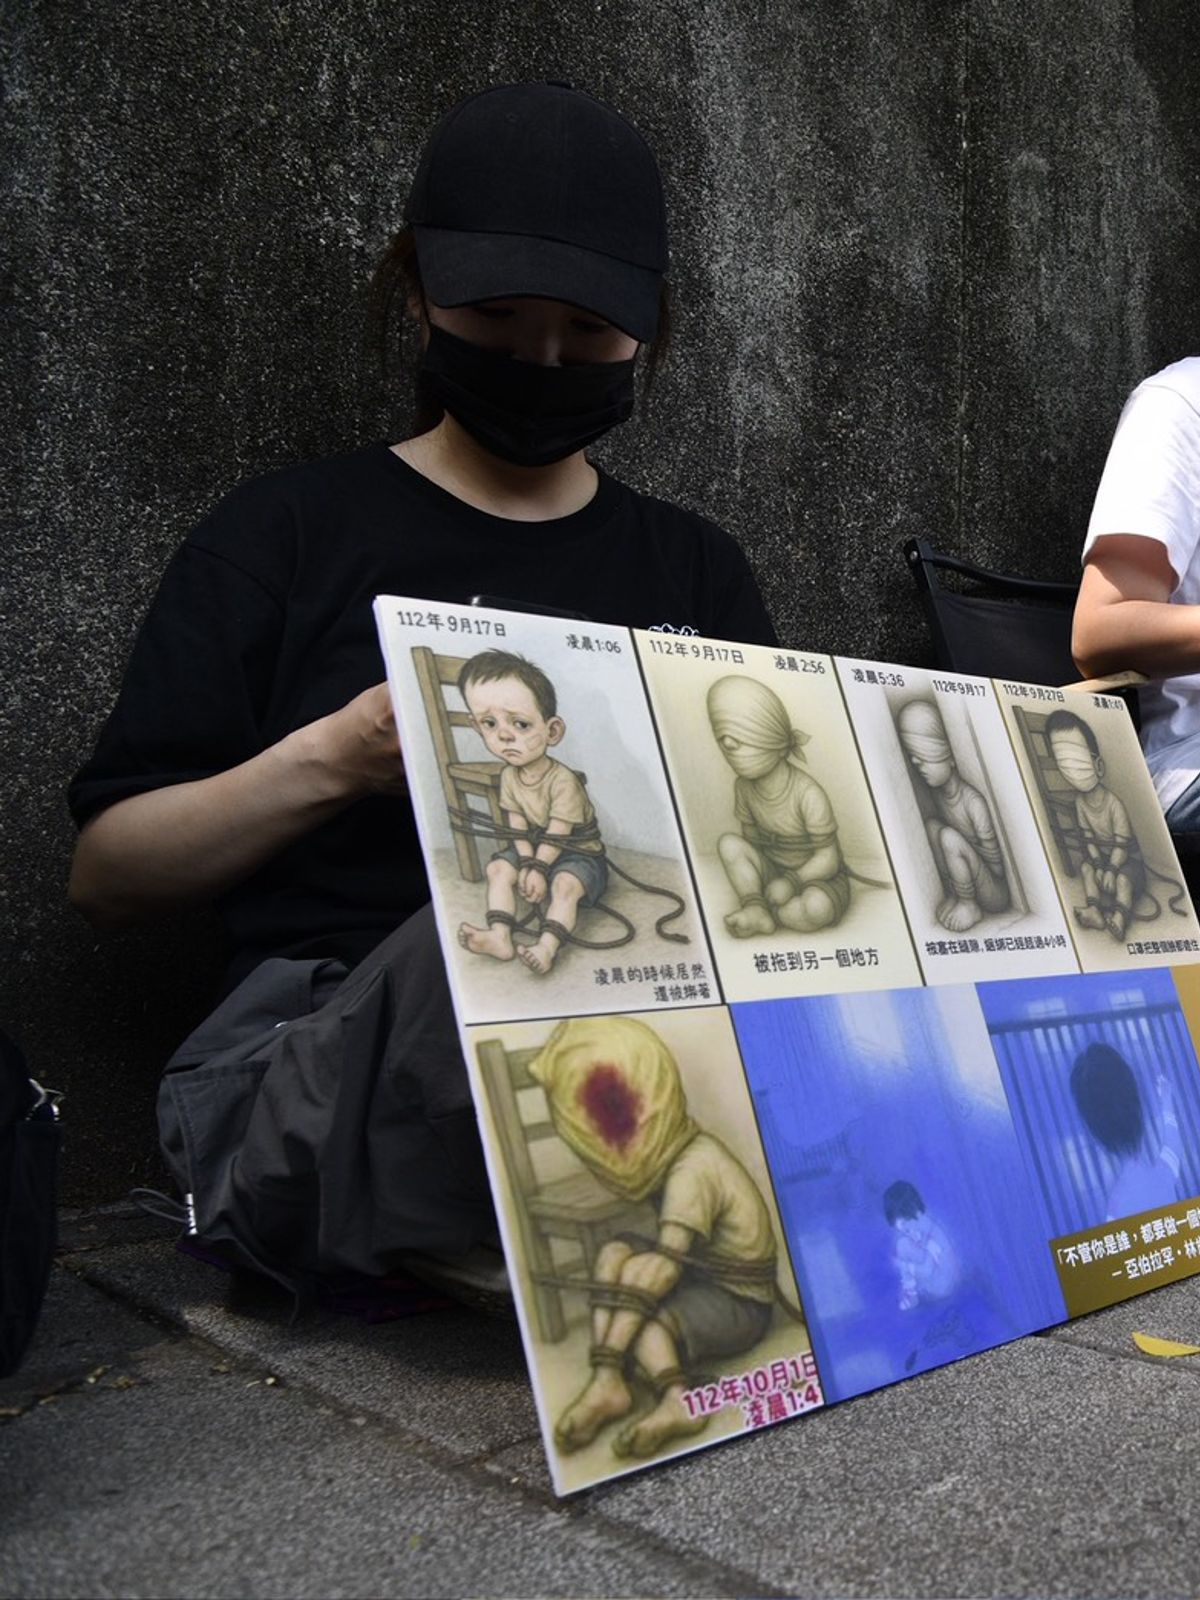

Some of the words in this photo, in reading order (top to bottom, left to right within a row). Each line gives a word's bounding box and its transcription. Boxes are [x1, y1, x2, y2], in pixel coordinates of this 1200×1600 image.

[397, 610, 507, 638] 112年9月17日
[566, 633, 622, 654] 凌晨1:06
[650, 639, 745, 665] 112年9月17日
[773, 654, 826, 675] 凌晨2:56
[851, 668, 905, 688] 凌晨5:36
[932, 679, 987, 698] 112年9月17
[1002, 683, 1065, 703] 112年9月27日
[753, 948, 880, 974] 被拖到另一個地方
[593, 962, 707, 986] 凌晨的時候居然
[683, 1352, 818, 1417] 112年10月1日
